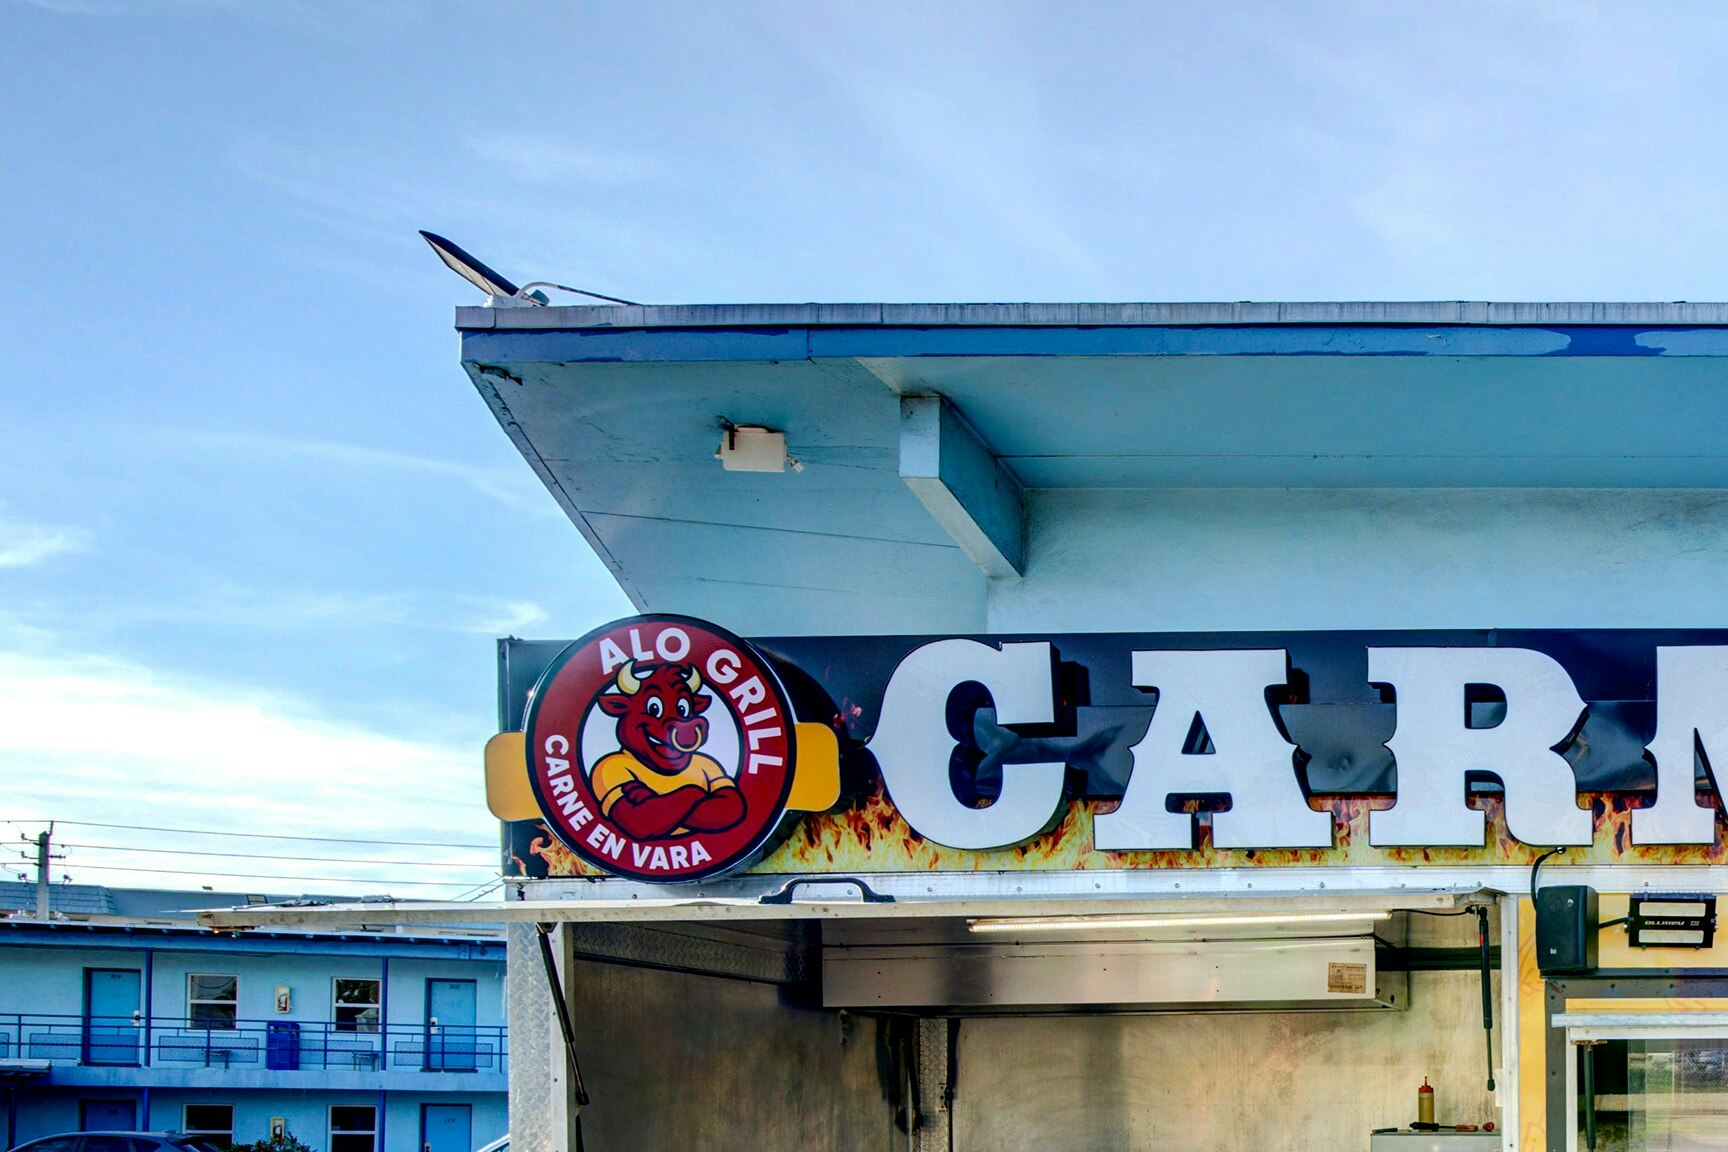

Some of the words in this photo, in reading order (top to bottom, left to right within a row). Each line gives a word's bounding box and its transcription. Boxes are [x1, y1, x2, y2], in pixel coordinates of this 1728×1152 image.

[598, 626, 691, 677] ALO
[706, 649, 784, 776] GRILL
[544, 734, 595, 827] CARNE
[586, 821, 620, 857] EN
[630, 838, 712, 871] VARA
